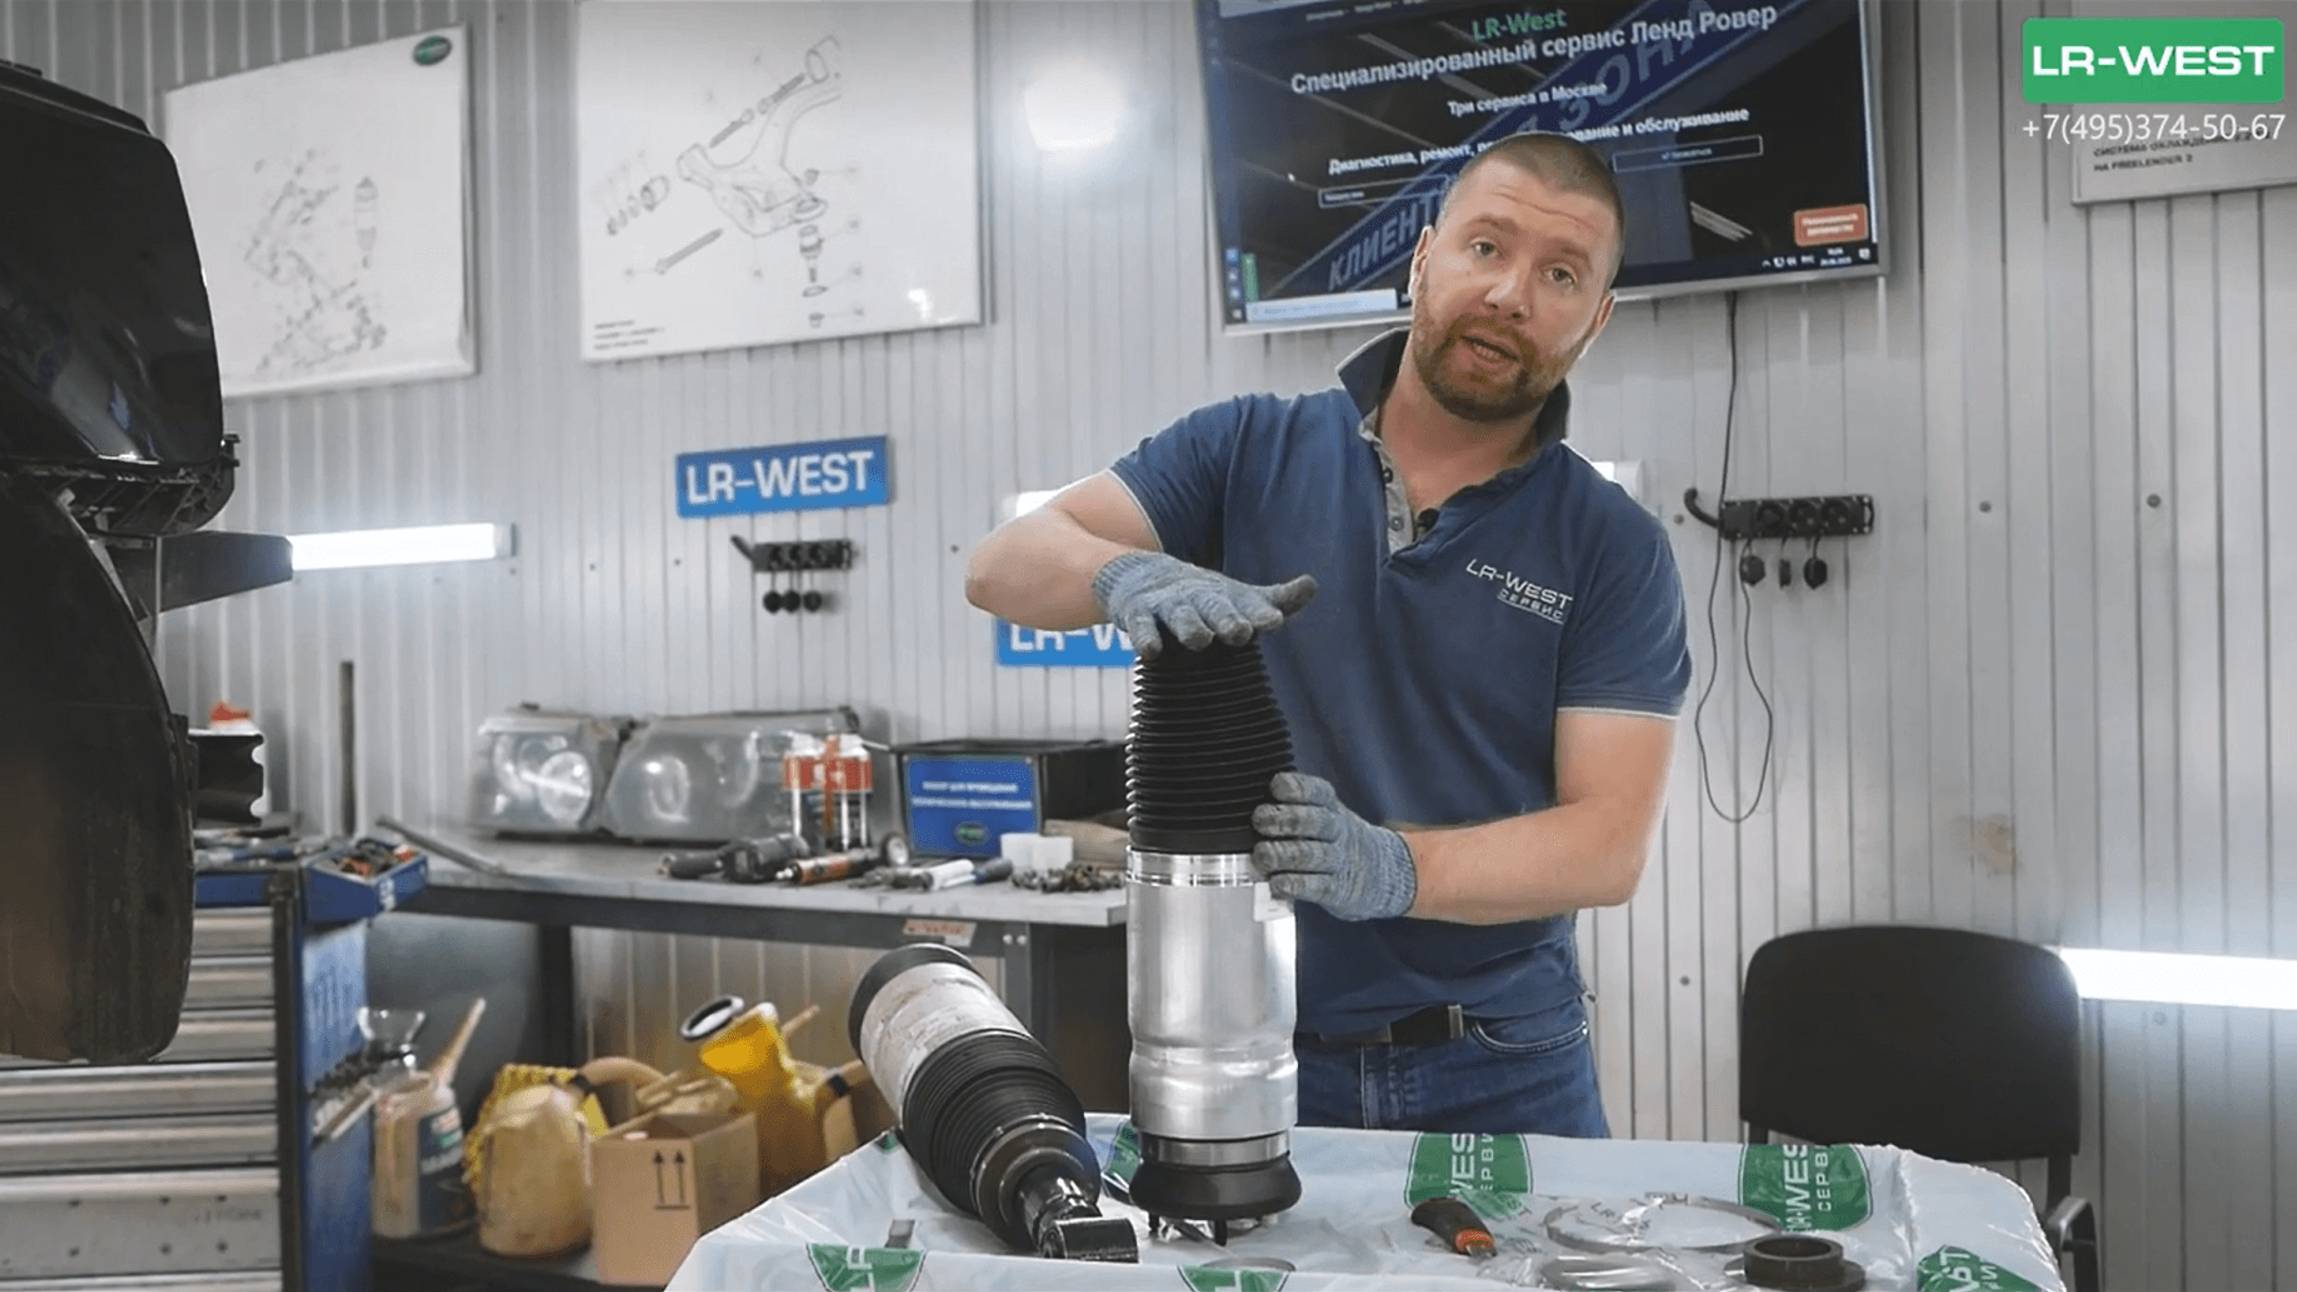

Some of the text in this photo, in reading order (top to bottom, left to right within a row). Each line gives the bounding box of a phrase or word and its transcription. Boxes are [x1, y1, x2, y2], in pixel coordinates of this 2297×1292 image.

[1291, 6, 1777, 94] Специализированный сервис Ленд Ровер
[1472, 8, 1567, 42] LR-West
[1448, 100, 1475, 117] Три
[1477, 93, 1537, 112] сервиса
[1552, 83, 1608, 101] Москве
[1635, 108, 1750, 134] обслуживание
[686, 451, 874, 504] LR-WEST
[1466, 558, 1573, 609] LR-WEST
[1814, 1151, 1832, 1212] СЕРВ
